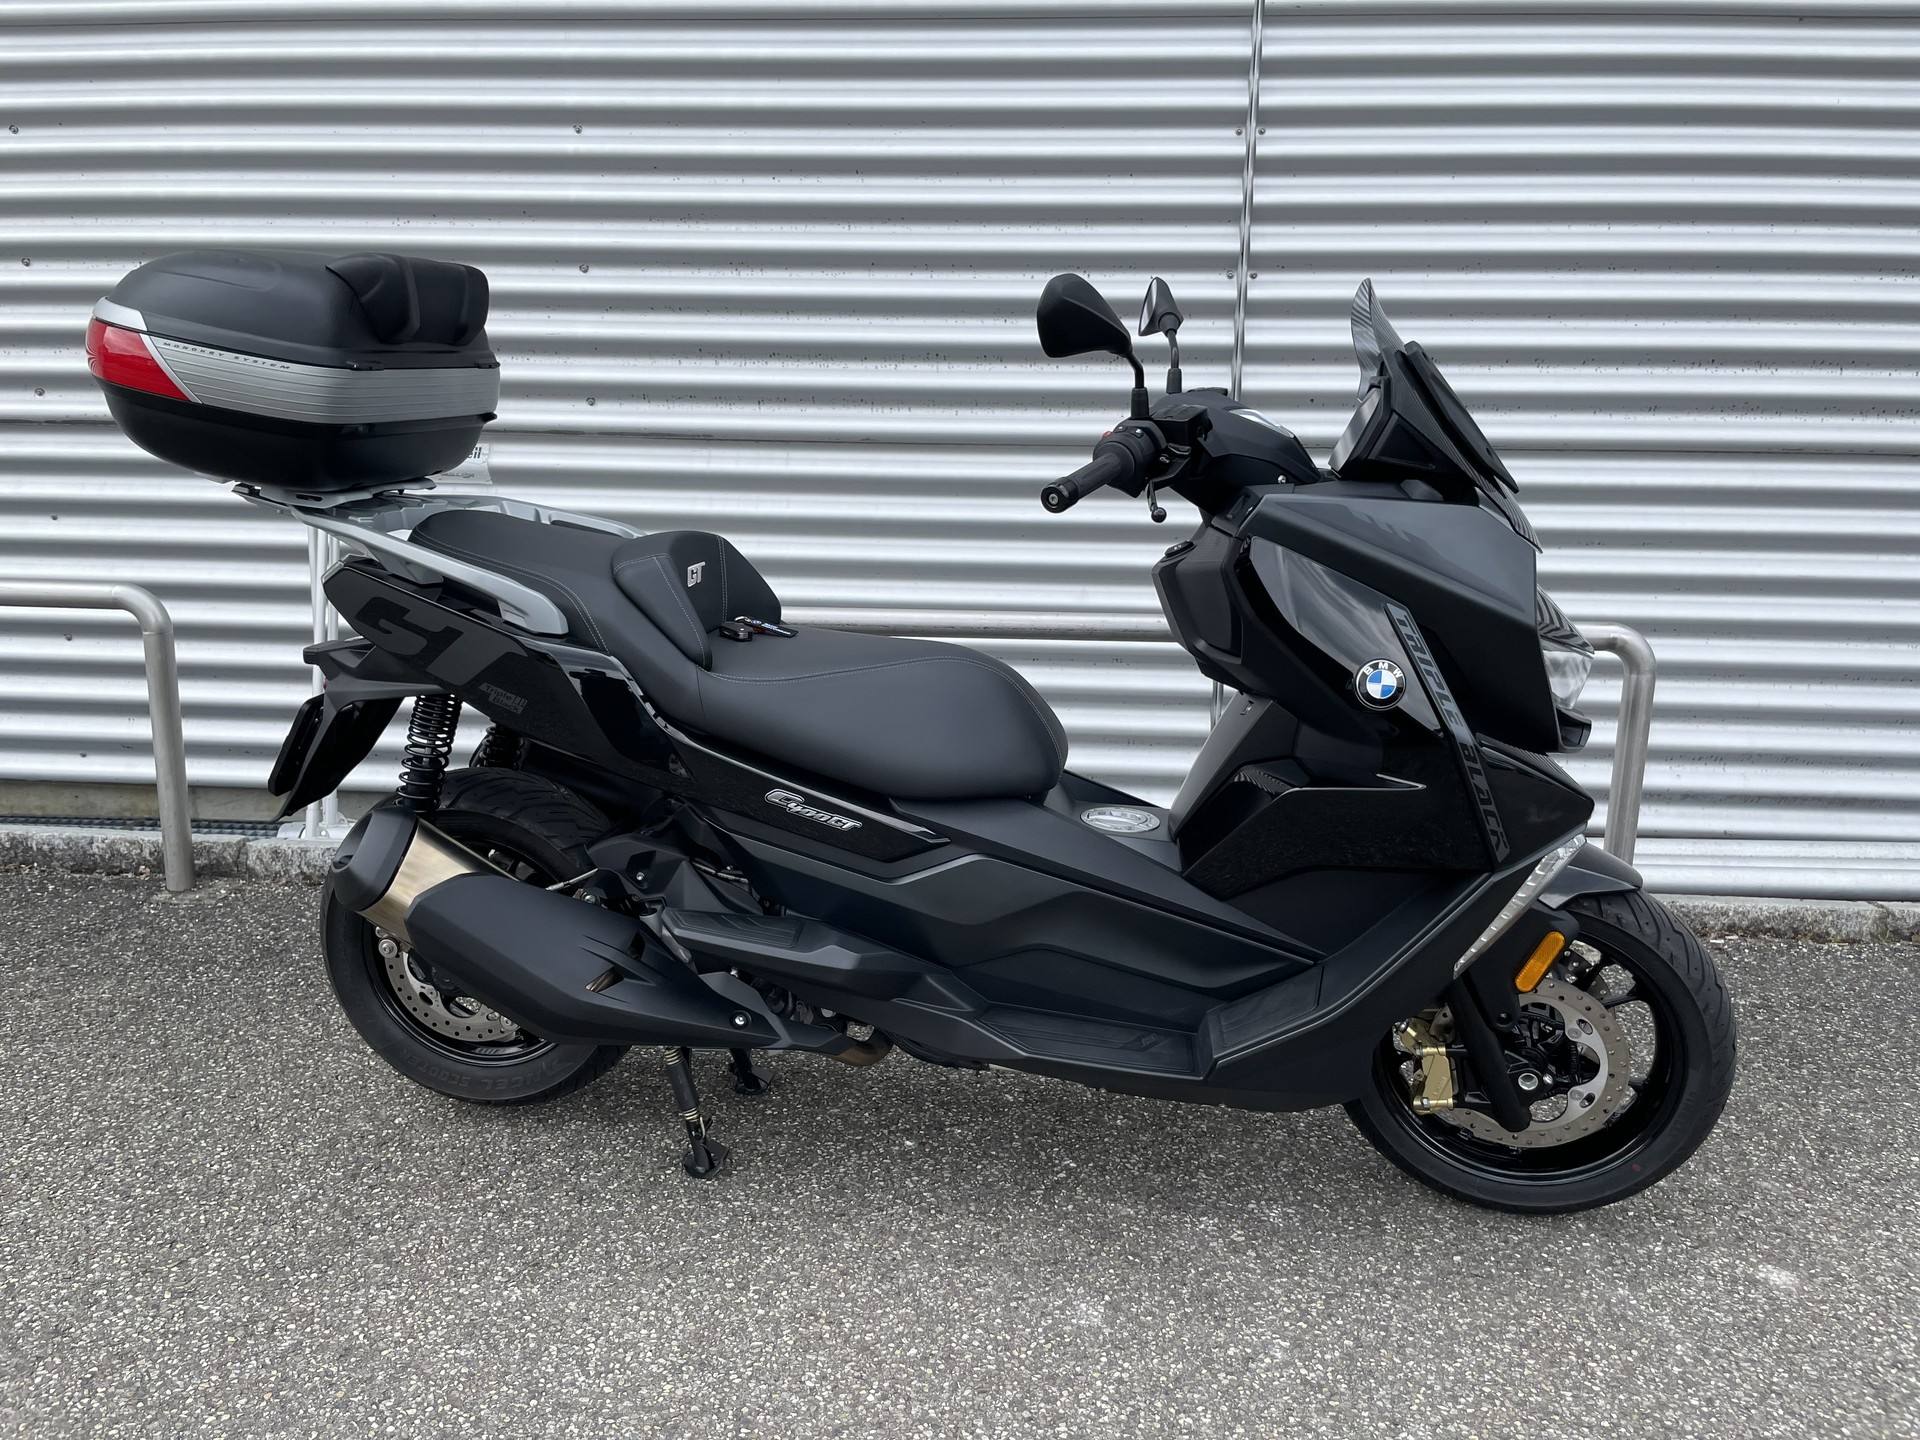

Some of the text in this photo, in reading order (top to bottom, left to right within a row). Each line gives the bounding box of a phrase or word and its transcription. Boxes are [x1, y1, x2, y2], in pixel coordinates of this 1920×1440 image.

[162, 342, 291, 370] MONOKEY SYSTEM
[687, 561, 706, 588] GT
[1362, 660, 1404, 679] BMW
[486, 683, 513, 701] Triple
[492, 696, 519, 713] Black
[1396, 614, 1509, 853] TRIPLE BLACK
